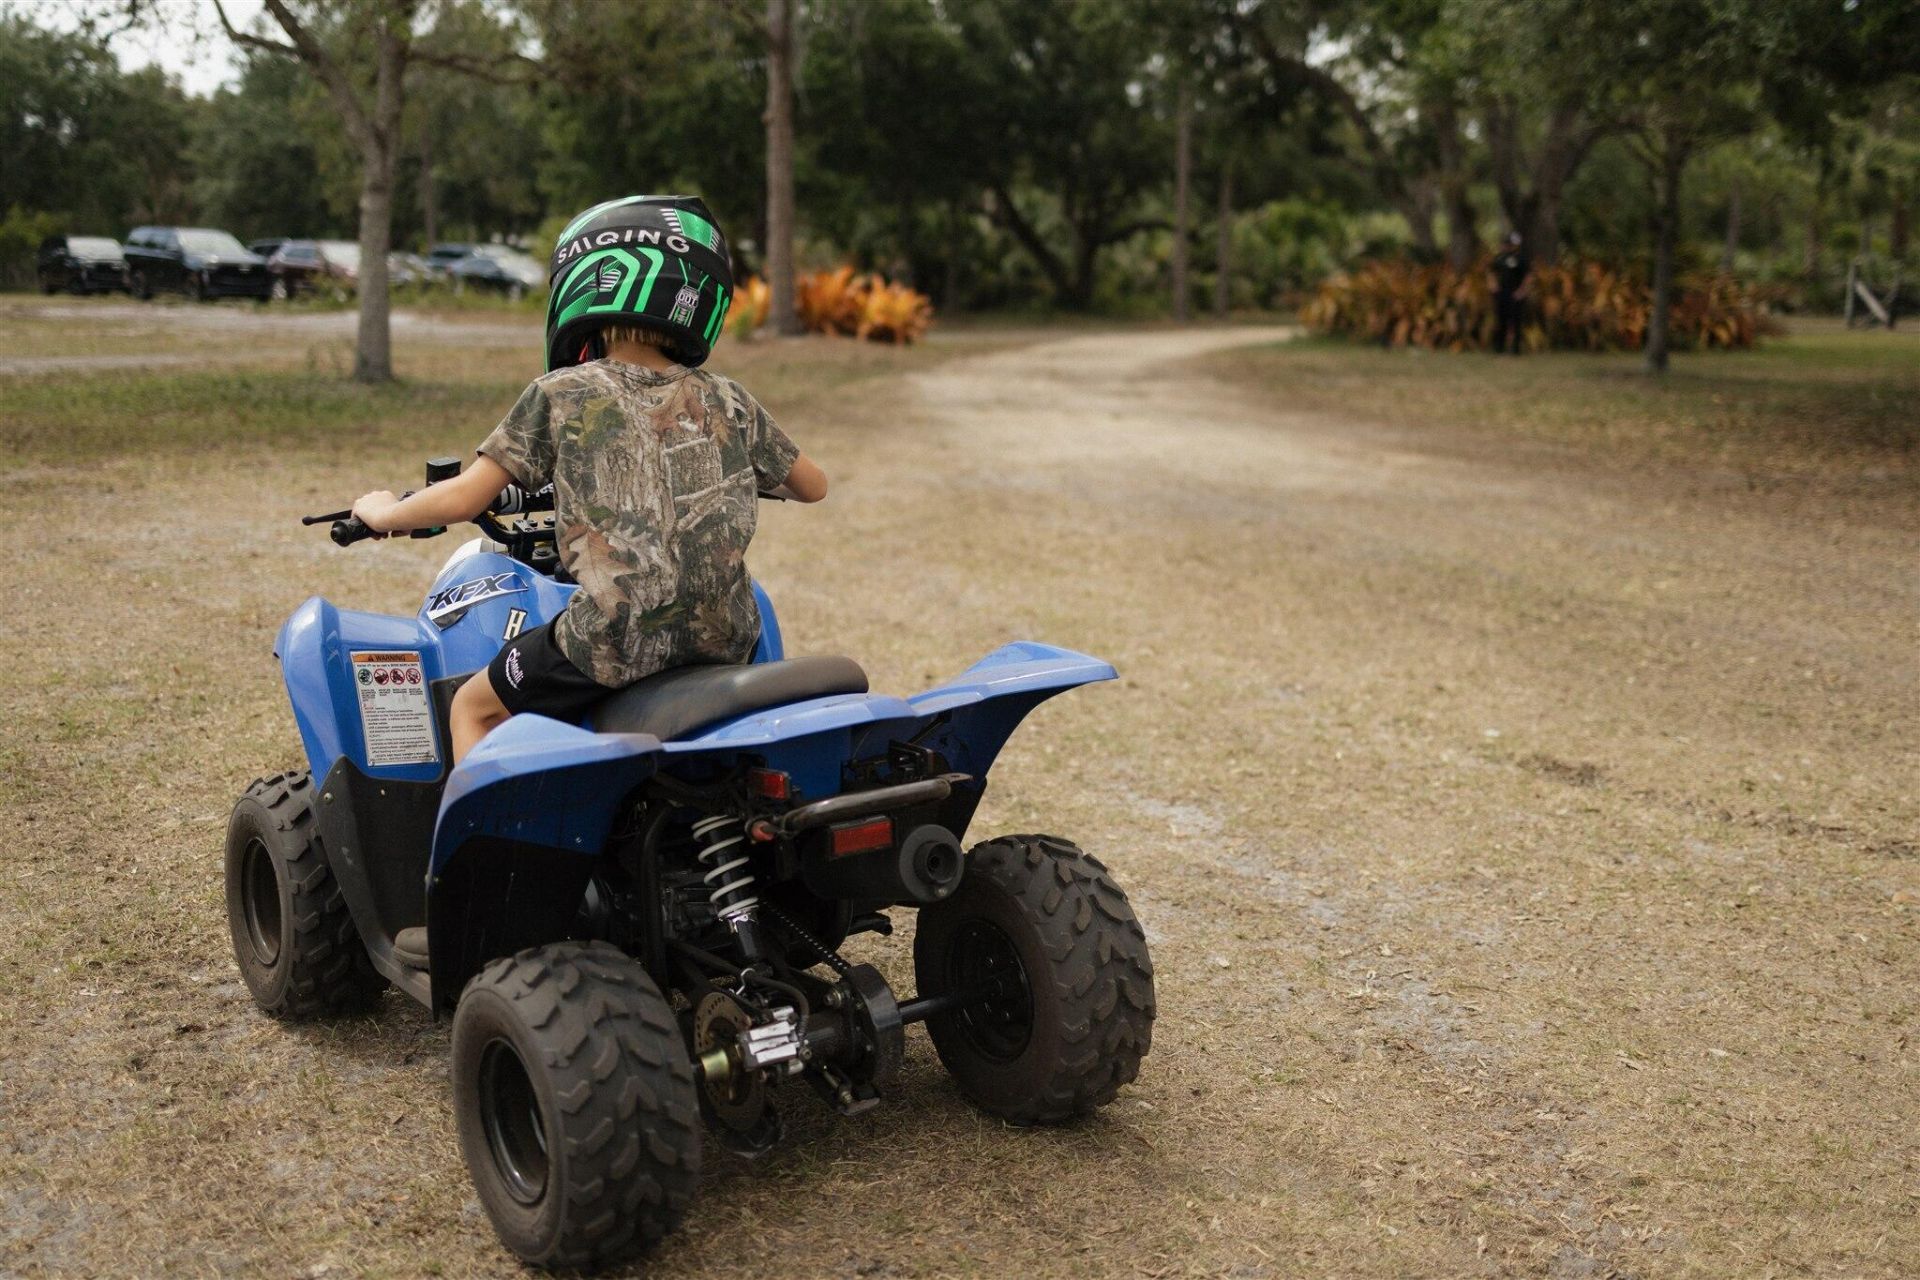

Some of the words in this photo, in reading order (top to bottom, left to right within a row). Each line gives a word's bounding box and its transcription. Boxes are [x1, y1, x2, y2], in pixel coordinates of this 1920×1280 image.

[558, 229, 690, 264] SAIQING
[429, 573, 515, 612] KFX
[375, 654, 406, 662] WARNING
